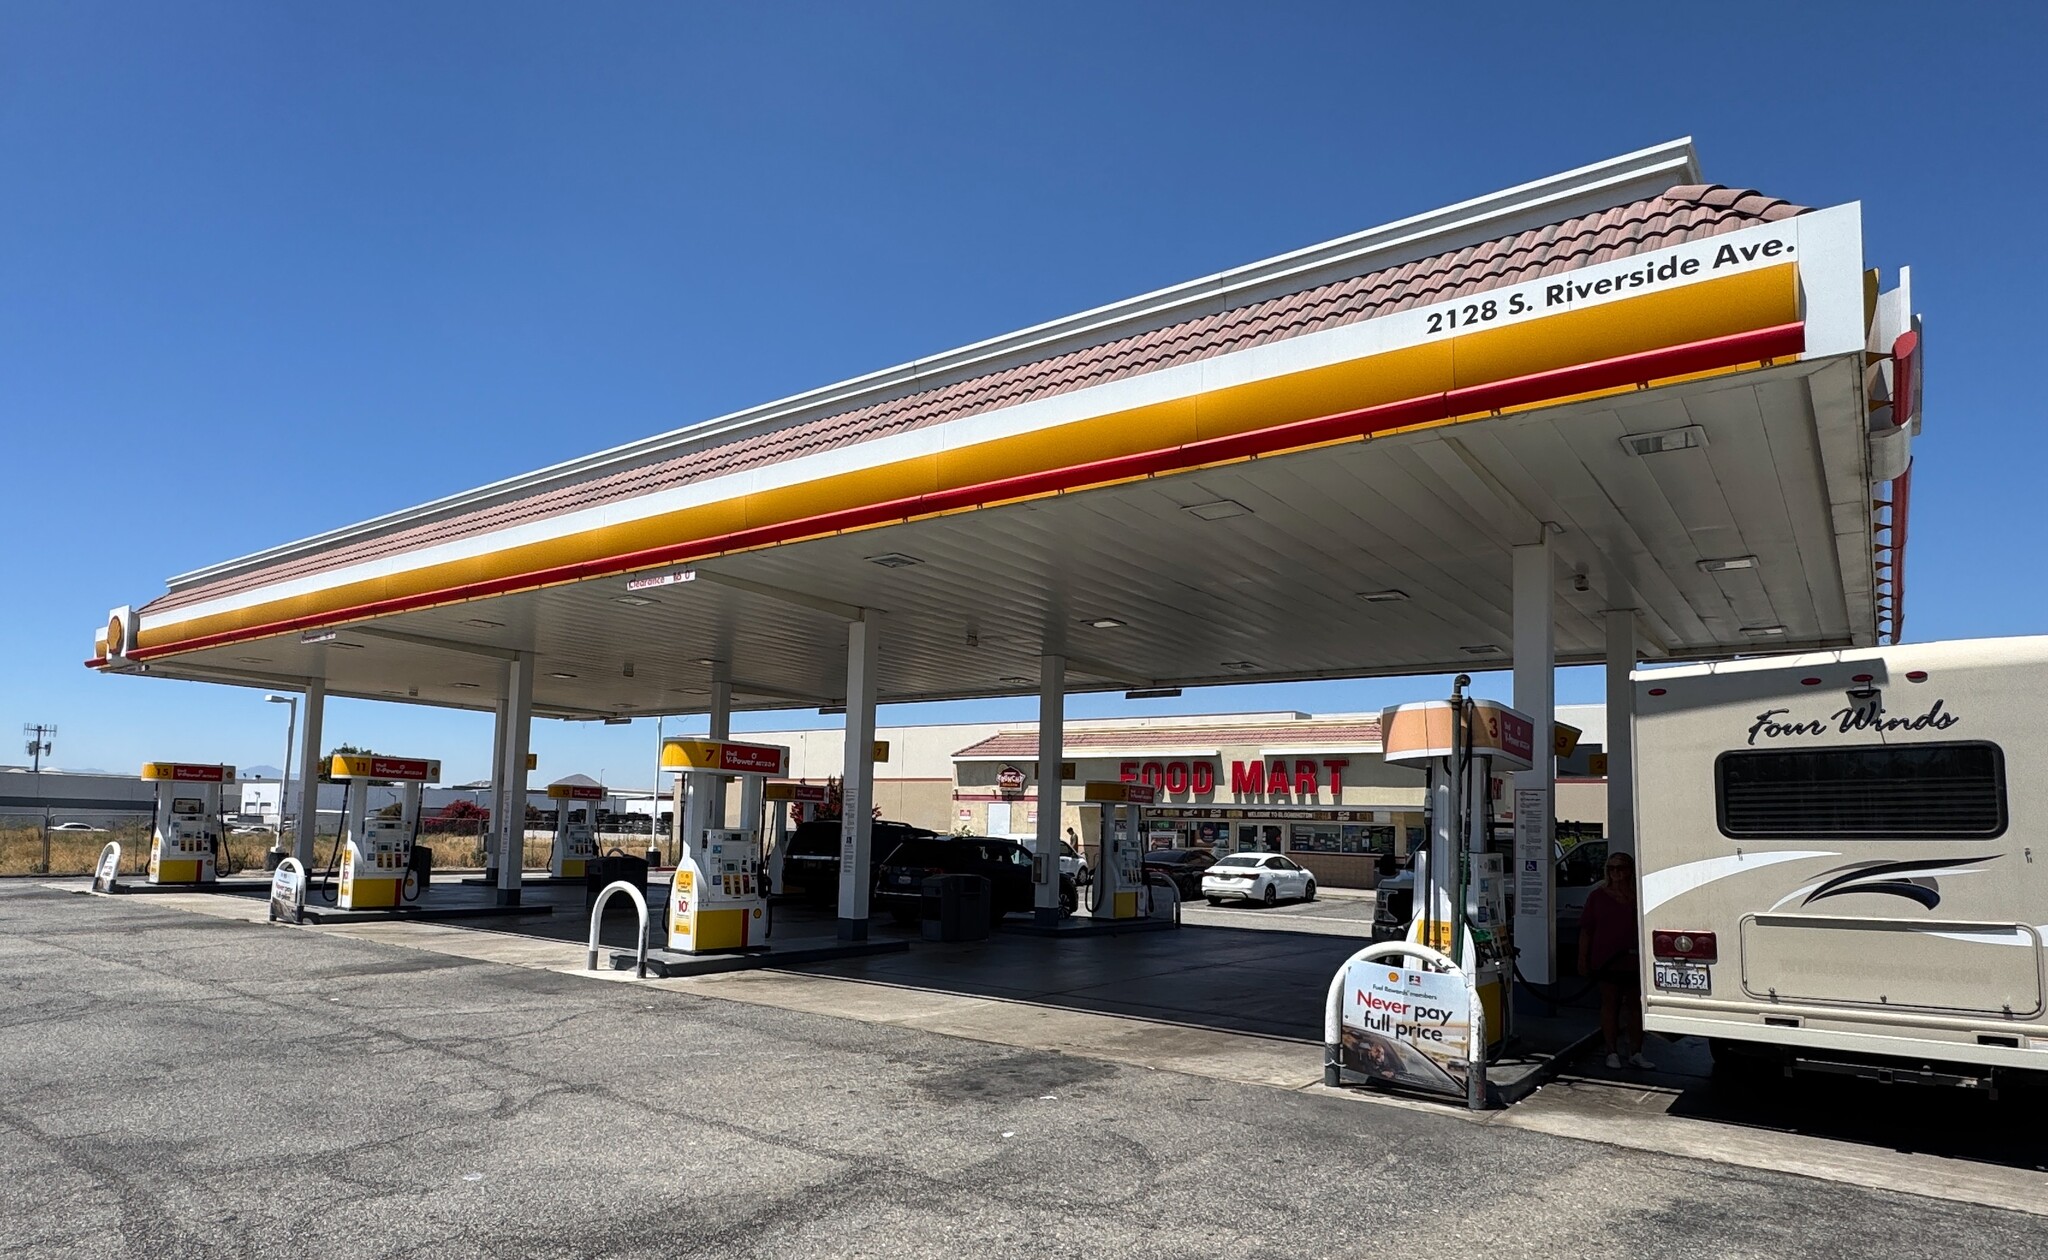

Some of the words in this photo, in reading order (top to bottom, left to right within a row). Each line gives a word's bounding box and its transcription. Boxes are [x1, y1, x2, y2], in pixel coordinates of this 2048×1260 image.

[1426, 299, 1498, 335] 2128
[1508, 292, 1534, 315] S.
[1546, 254, 1701, 308] Riverside
[1712, 238, 1796, 269] Ave.
[629, 577, 665, 589] Clearance
[1489, 717, 1499, 739] 3
[1747, 707, 1827, 746] Four
[1830, 699, 1960, 734] Winds
[1557, 736, 1569, 749] 3
[705, 749, 715, 762] 7
[876, 748, 882, 757] 7
[356, 762, 366, 772] 11
[726, 756, 755, 767] V-Power
[156, 768, 169, 777] 15
[1120, 760, 1214, 795] FOOD
[1231, 759, 1350, 796] MART
[1120, 788, 1128, 797] 5
[1278, 811, 1313, 819] BLOOMINGTON
[1657, 971, 1706, 986] 8LGZ659
[1372, 983, 1384, 991] Fuel
[1409, 991, 1438, 1000] members
[1357, 989, 1411, 1015] Never
[1414, 1005, 1453, 1026] pay
[1364, 1010, 1390, 1032] full
[1395, 1023, 1443, 1042] price
